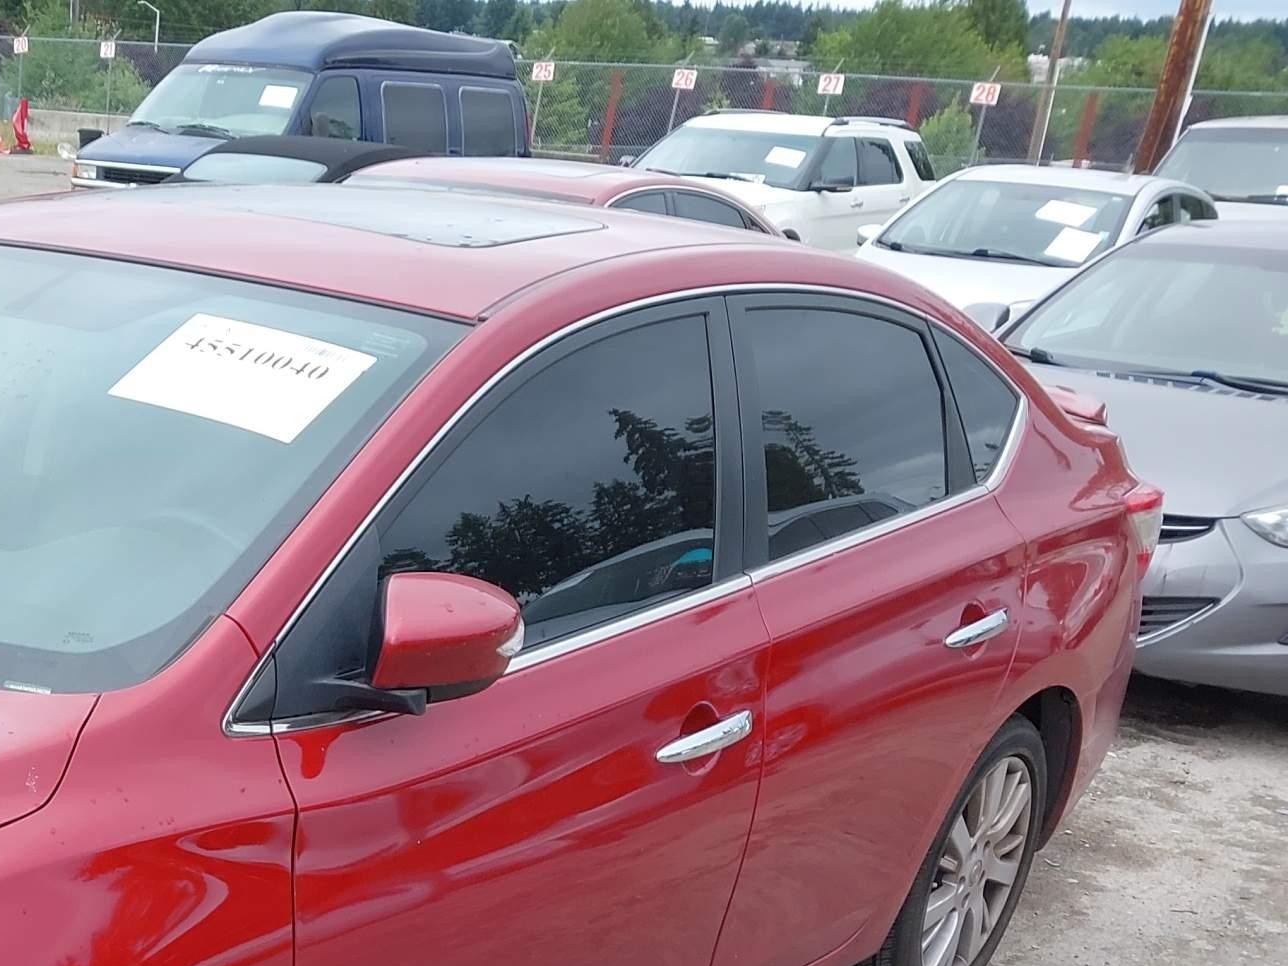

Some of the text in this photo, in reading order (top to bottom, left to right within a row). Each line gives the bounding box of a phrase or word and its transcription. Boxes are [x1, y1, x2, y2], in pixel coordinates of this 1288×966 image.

[15, 37, 27, 52] 20
[103, 42, 114, 57] 21
[535, 63, 552, 79] 25
[675, 69, 694, 88] 26
[822, 74, 841, 92] 27
[974, 83, 997, 102] 28
[184, 335, 331, 380] 45510040
